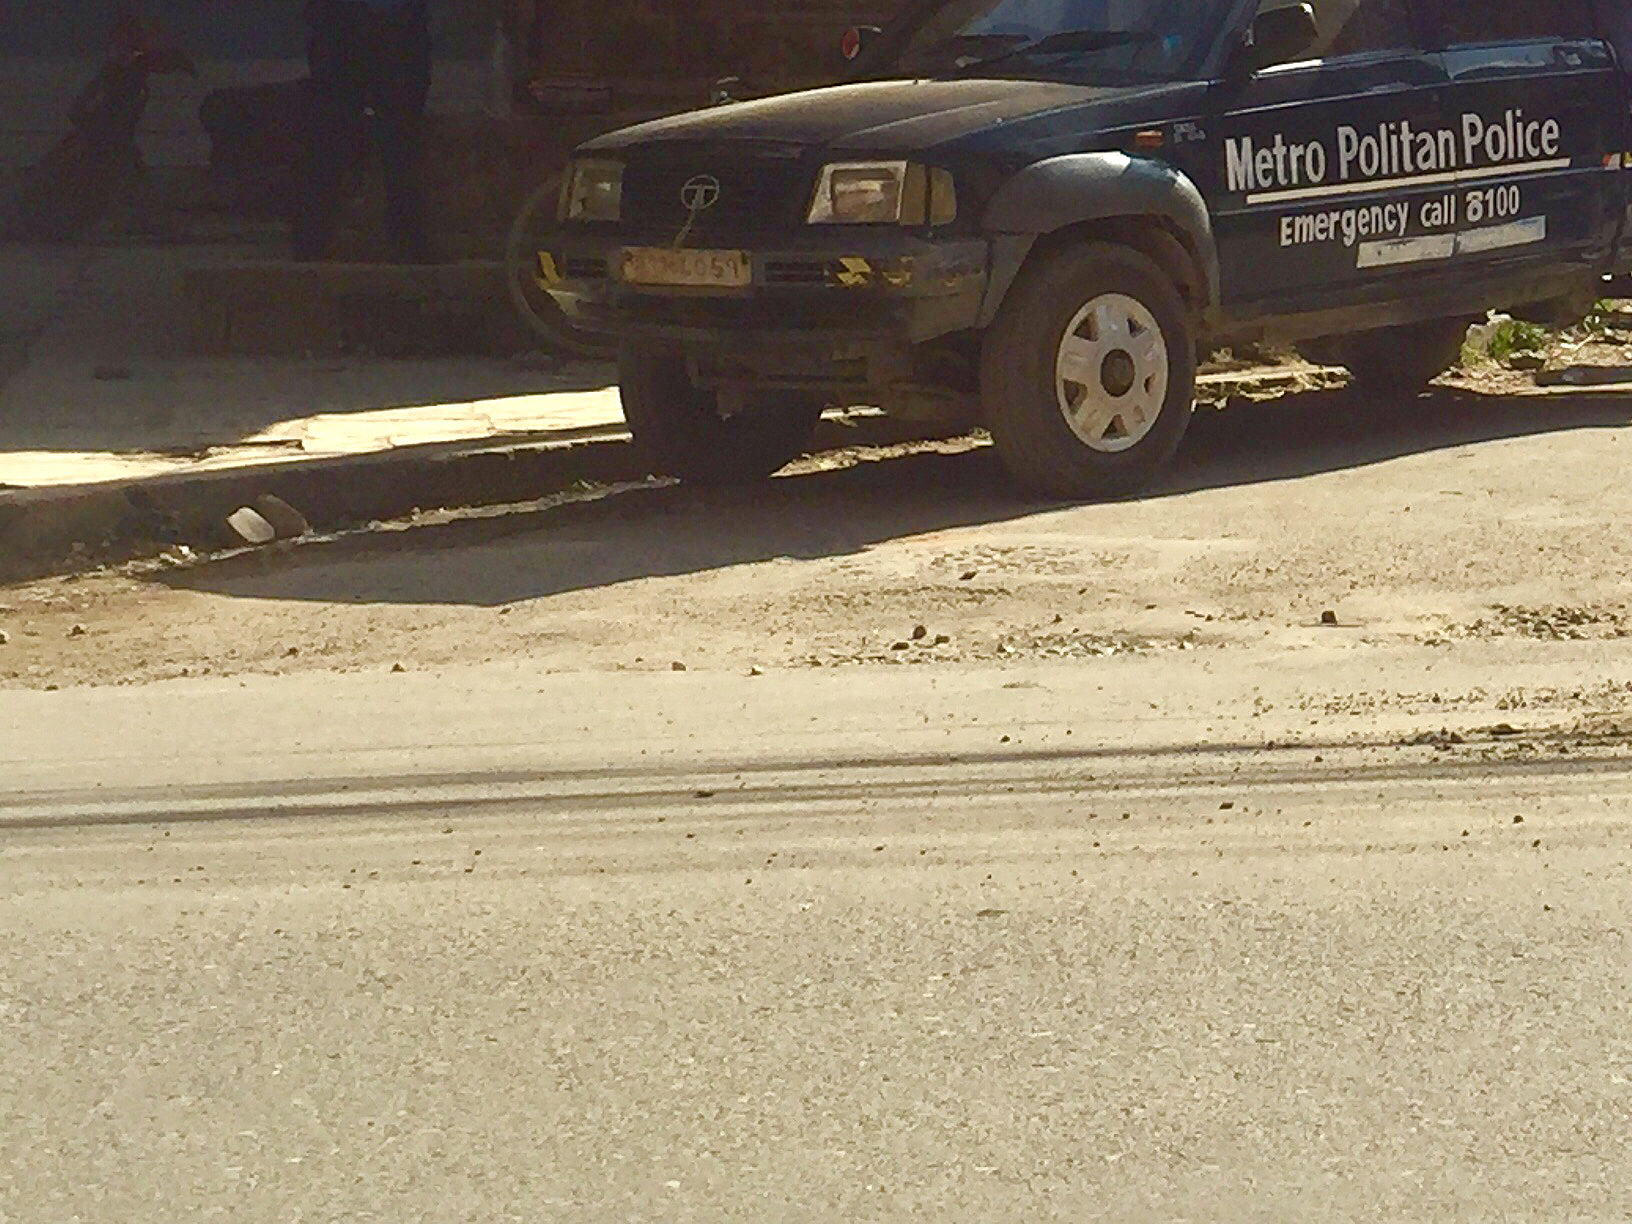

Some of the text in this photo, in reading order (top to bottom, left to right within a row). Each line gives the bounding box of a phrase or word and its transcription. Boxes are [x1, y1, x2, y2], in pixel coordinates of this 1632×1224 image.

[1225, 109, 1560, 191] Metro Politan Police
[1280, 200, 1409, 247] Emergency
[1420, 194, 1456, 228] call
